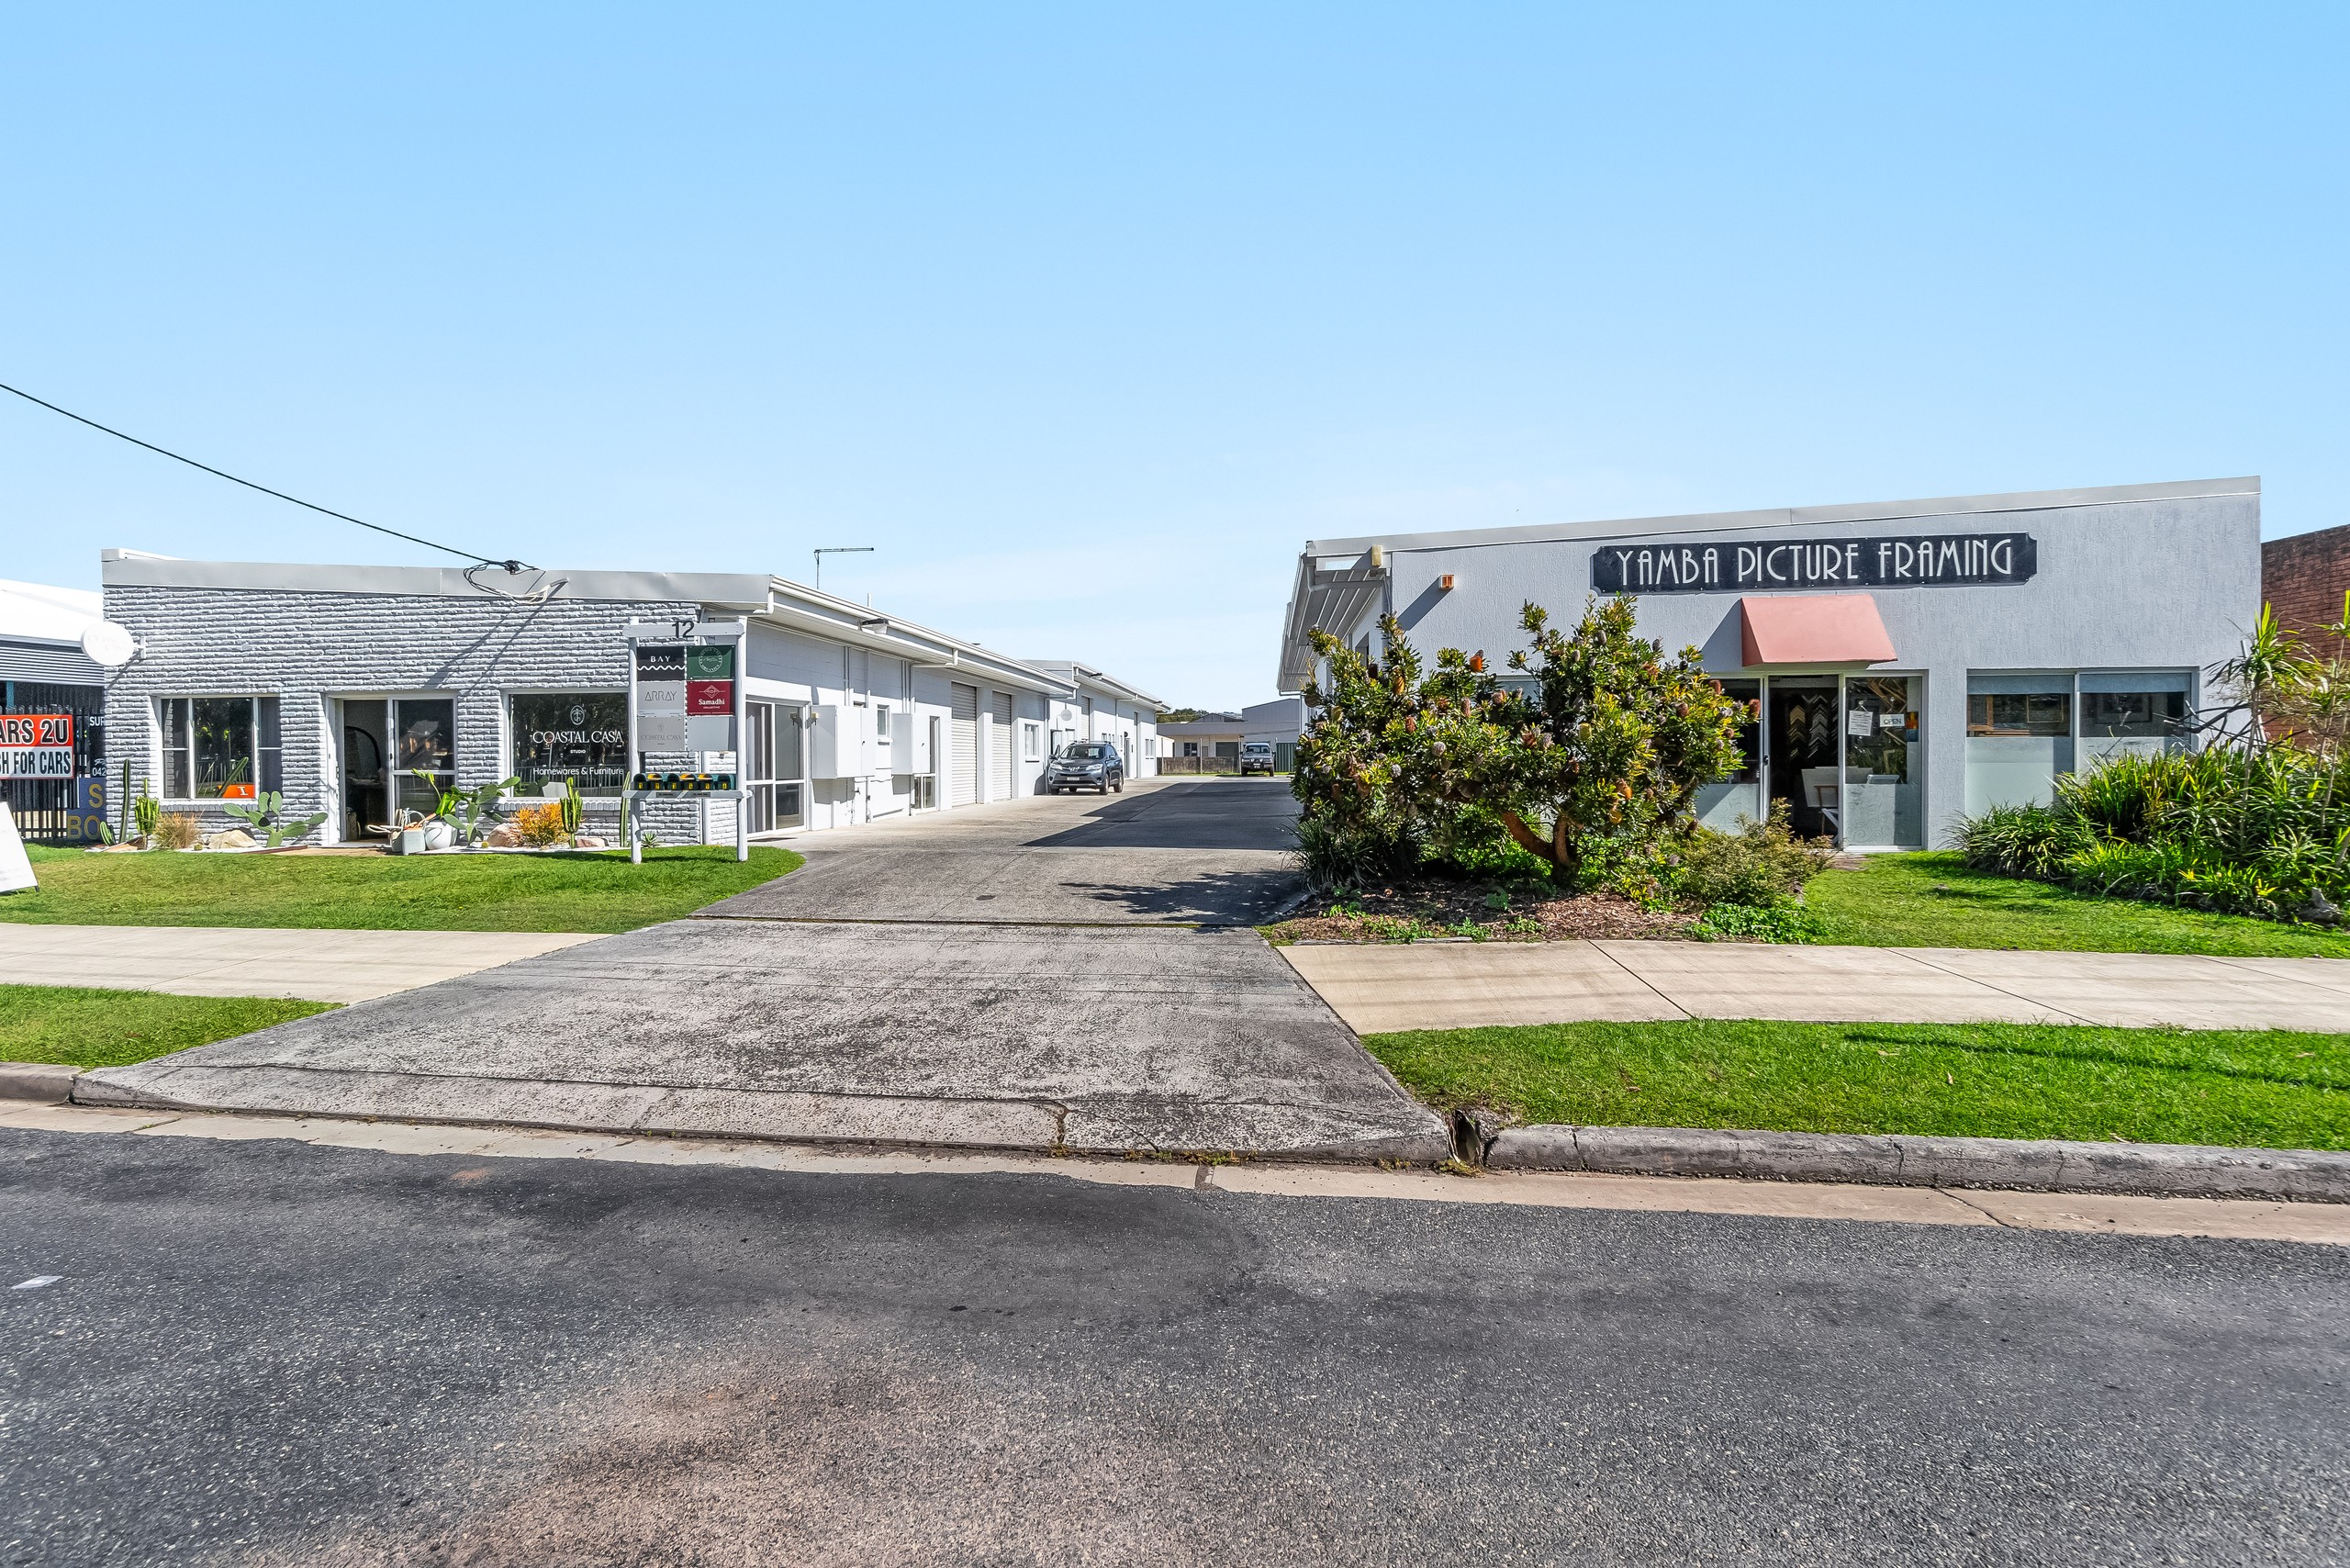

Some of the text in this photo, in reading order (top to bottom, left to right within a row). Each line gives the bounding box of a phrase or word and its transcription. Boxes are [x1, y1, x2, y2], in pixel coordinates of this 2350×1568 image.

[1616, 539, 2012, 586] YAMBA PICTURE FRAMING
[672, 621, 695, 638] 12
[644, 690, 677, 701] ARRAY
[699, 698, 725, 706] Samadhi
[39, 718, 69, 745] 2U
[532, 731, 624, 744] COASTAL CASA
[0, 751, 71, 775] H FOR CARS
[532, 767, 624, 776] Homewares & Furniture
